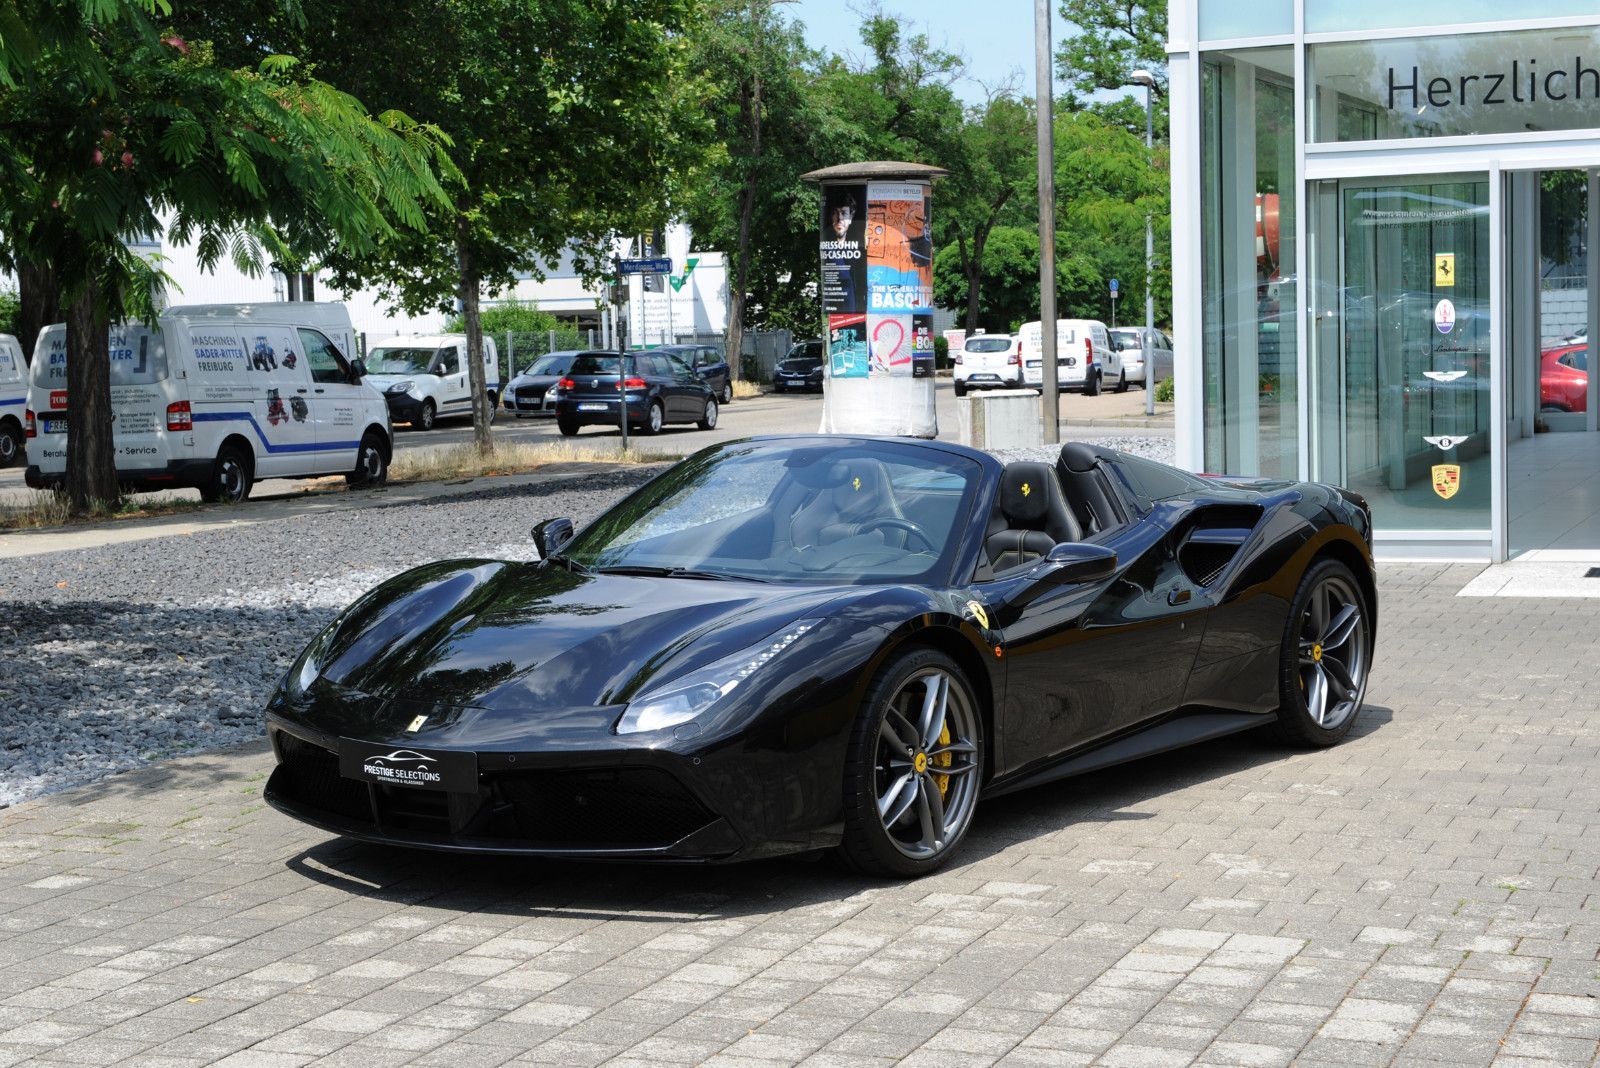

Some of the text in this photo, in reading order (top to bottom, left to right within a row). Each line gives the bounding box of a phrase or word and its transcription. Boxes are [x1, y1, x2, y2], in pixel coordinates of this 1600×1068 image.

[1388, 56, 1600, 110] Herzlich
[917, 327, 928, 335] DIE
[191, 335, 237, 346] MASCHINEN
[194, 348, 244, 359] BADER-RITTER
[197, 361, 234, 372] FREIBURG
[43, 450, 67, 458] Beratu
[125, 446, 158, 455] Service
[364, 764, 441, 782] PRESTIGE SELECTIONS
